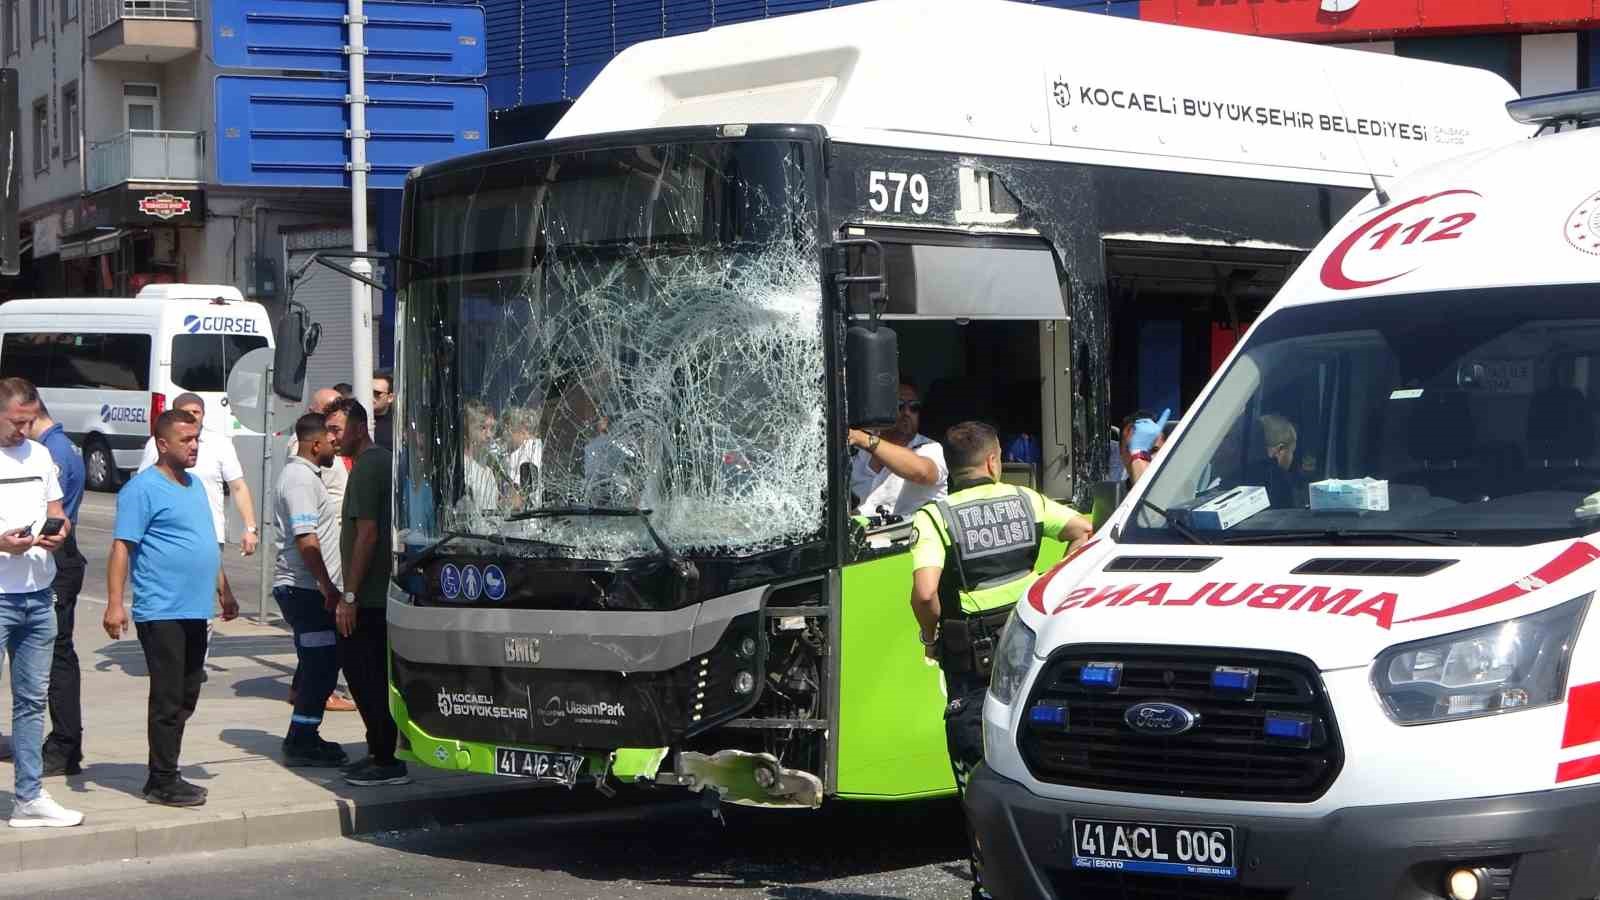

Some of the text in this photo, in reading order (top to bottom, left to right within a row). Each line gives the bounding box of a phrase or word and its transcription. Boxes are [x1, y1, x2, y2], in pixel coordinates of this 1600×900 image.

[1183, 98, 1314, 128] BÜYÜKŞEHİR
[869, 171, 929, 215] 579
[1369, 213, 1476, 250] 112
[202, 316, 259, 333] GÜRSEL
[958, 500, 1026, 528] TRAFİK
[966, 520, 1030, 551] POLİSİ
[504, 638, 541, 662] BMC
[1136, 707, 1177, 729] Ford
[501, 751, 516, 773] 41
[1081, 823, 1226, 864] 41 ACL 006
